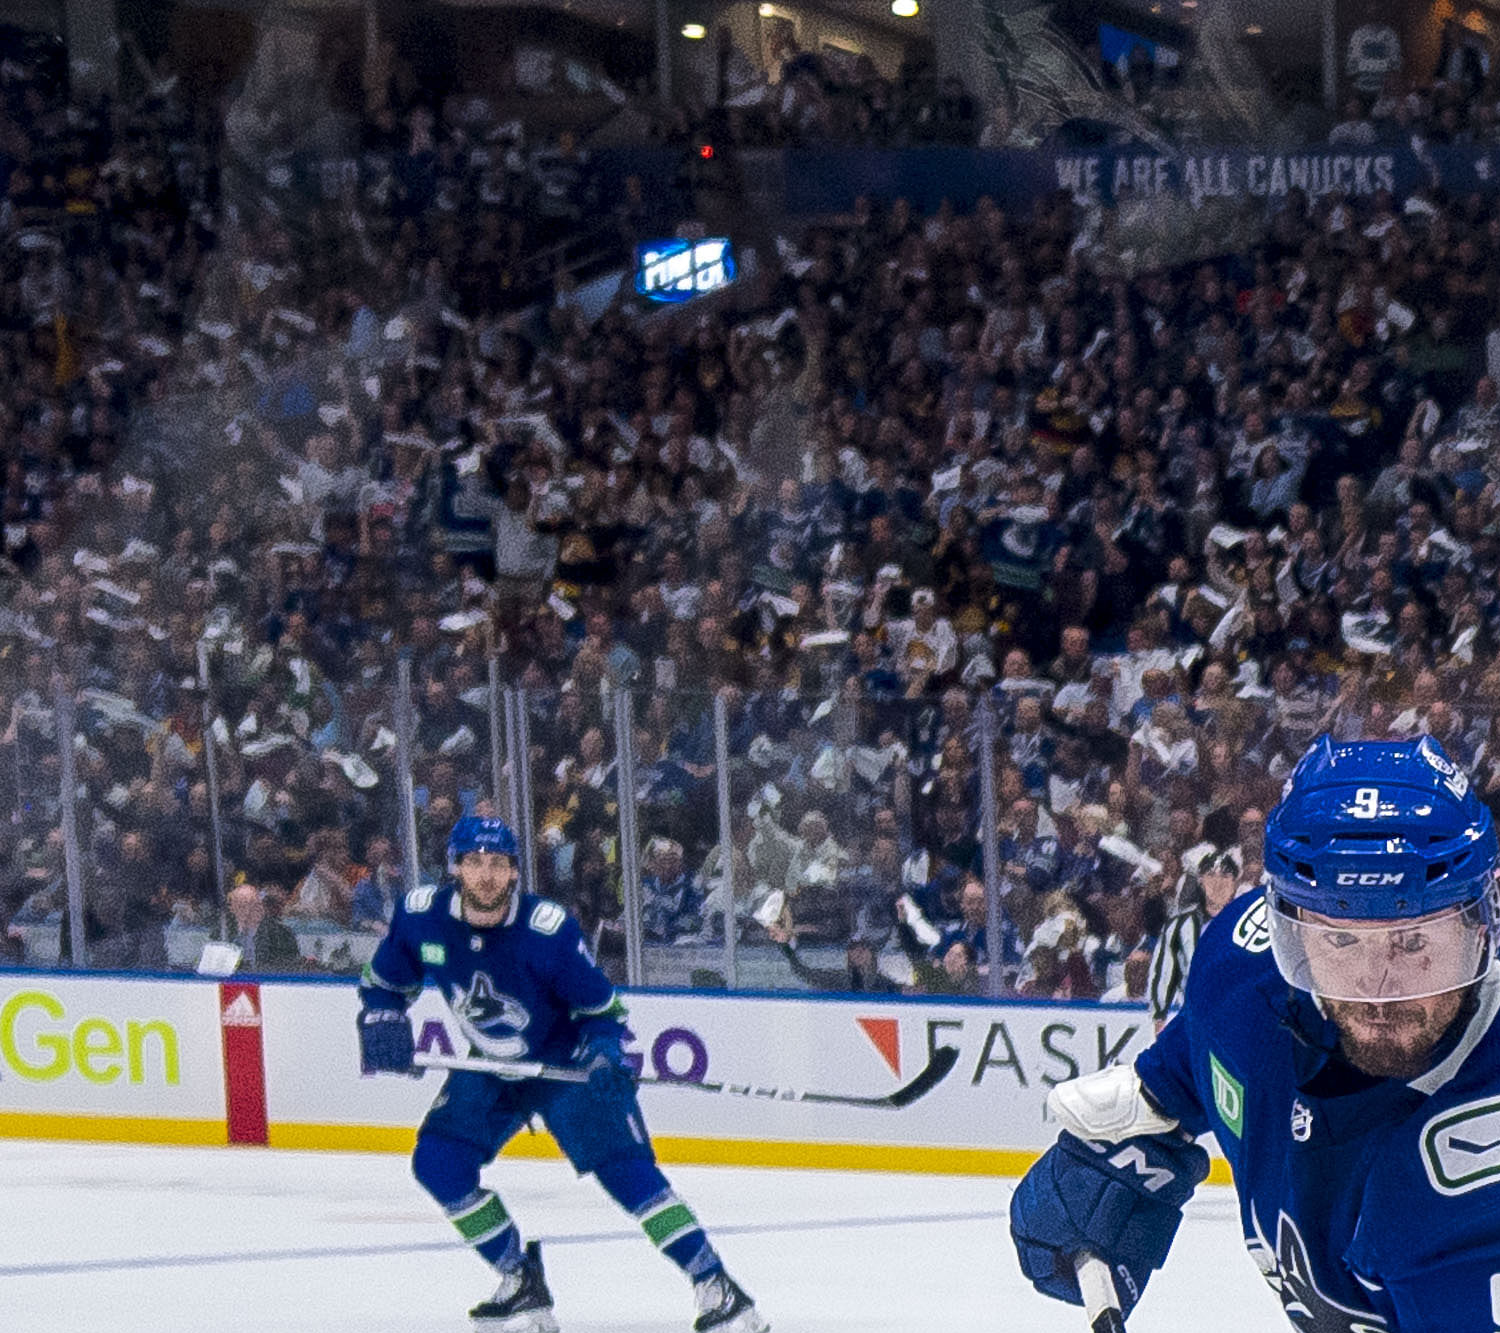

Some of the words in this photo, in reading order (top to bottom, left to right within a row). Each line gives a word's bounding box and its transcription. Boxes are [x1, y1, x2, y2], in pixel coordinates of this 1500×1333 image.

[1355, 787, 1379, 819] 9
[1337, 872, 1405, 886] CCM
[0, 991, 181, 1086] Gen
